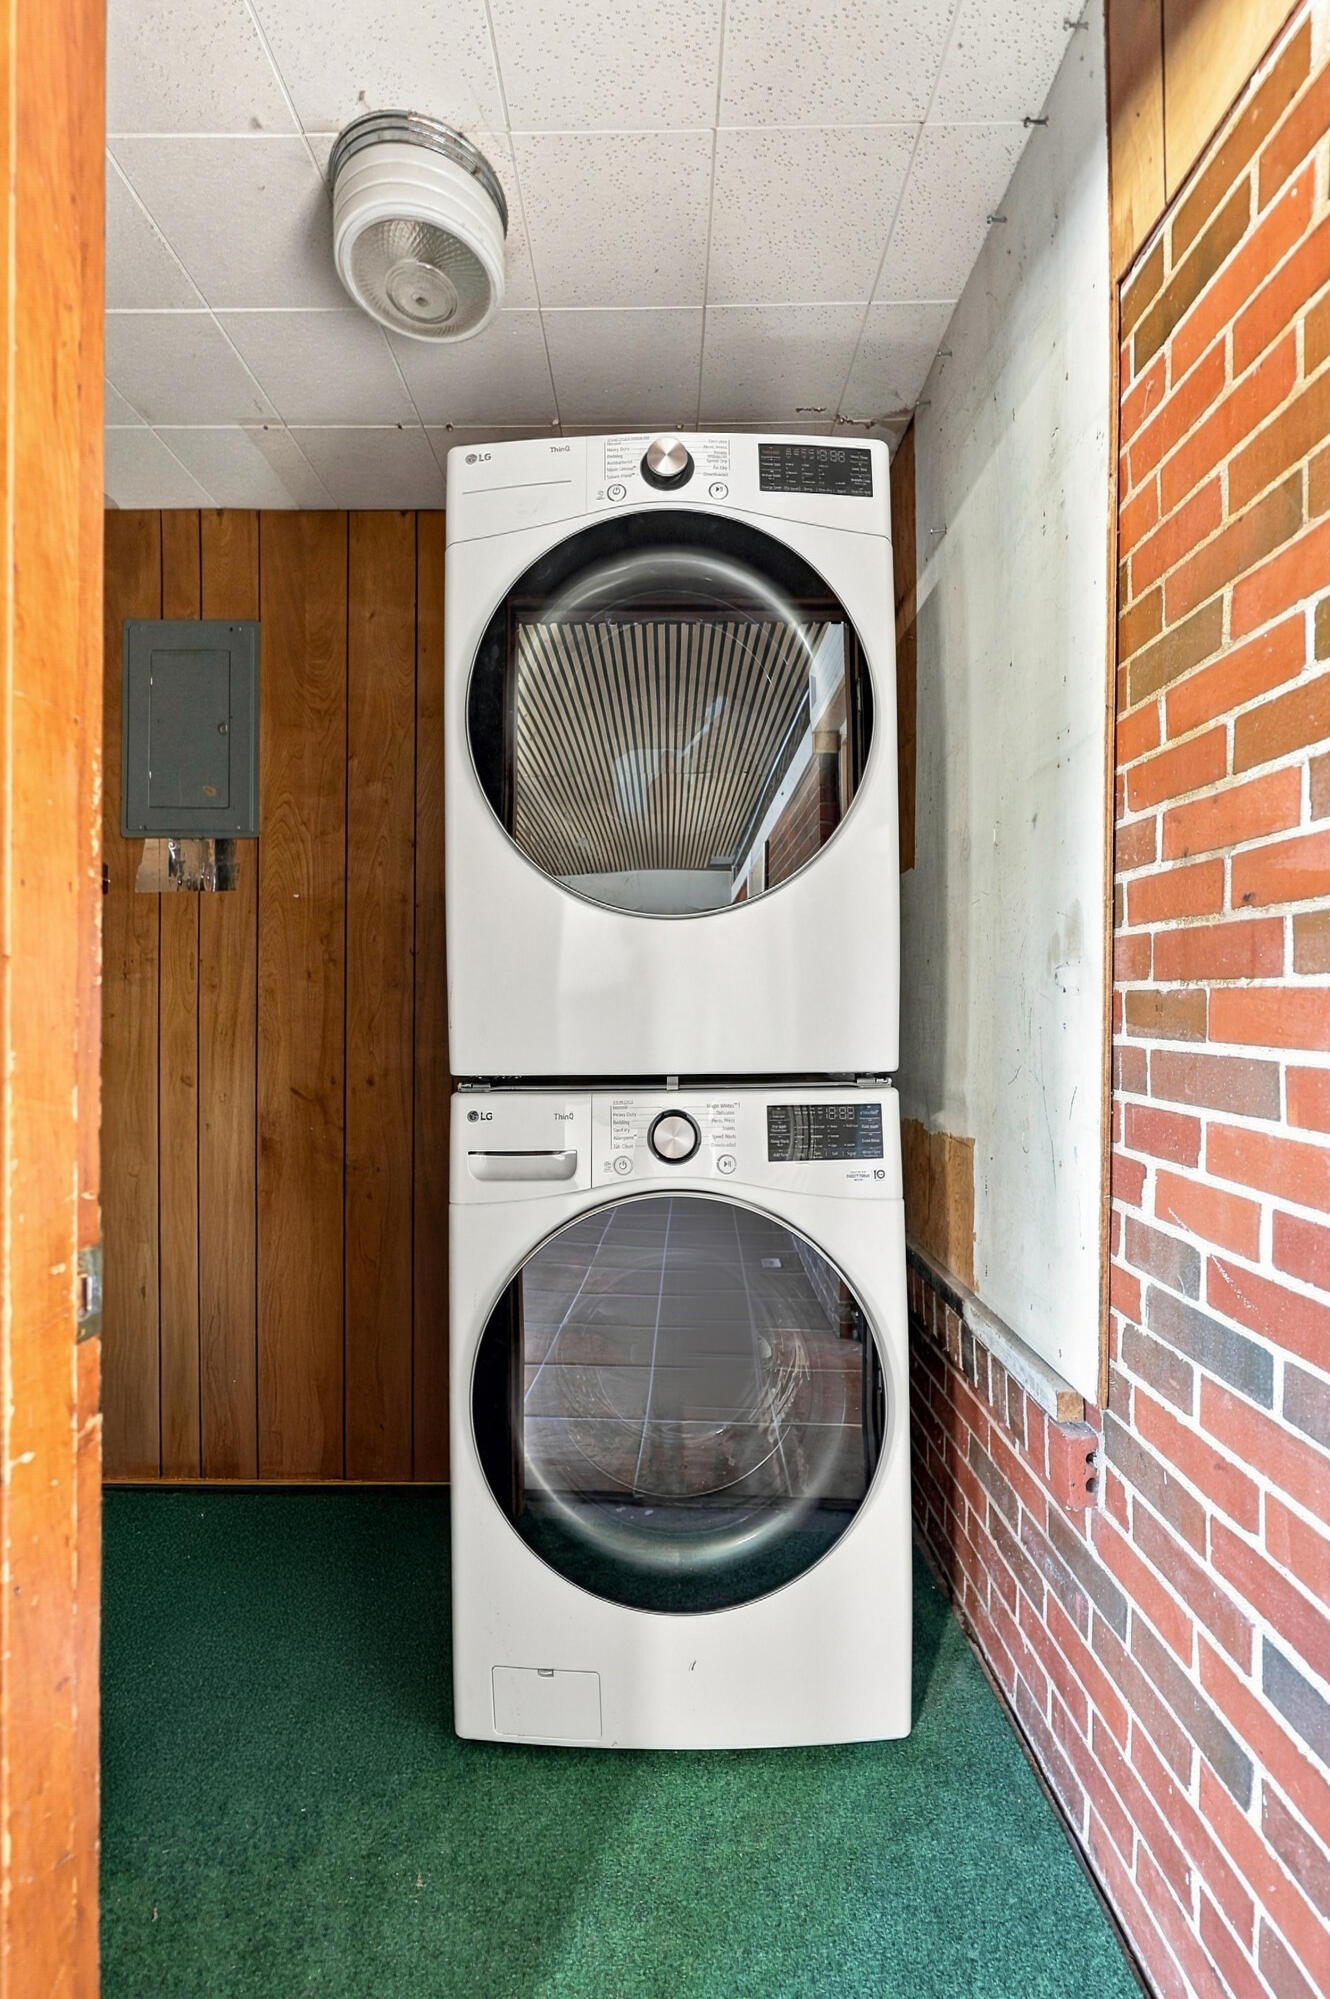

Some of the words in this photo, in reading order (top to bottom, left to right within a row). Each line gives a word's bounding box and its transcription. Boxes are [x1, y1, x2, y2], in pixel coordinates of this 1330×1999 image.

[550, 445, 570, 453] ThinQ
[478, 453, 492, 462] LG
[480, 1112, 493, 1121] LG
